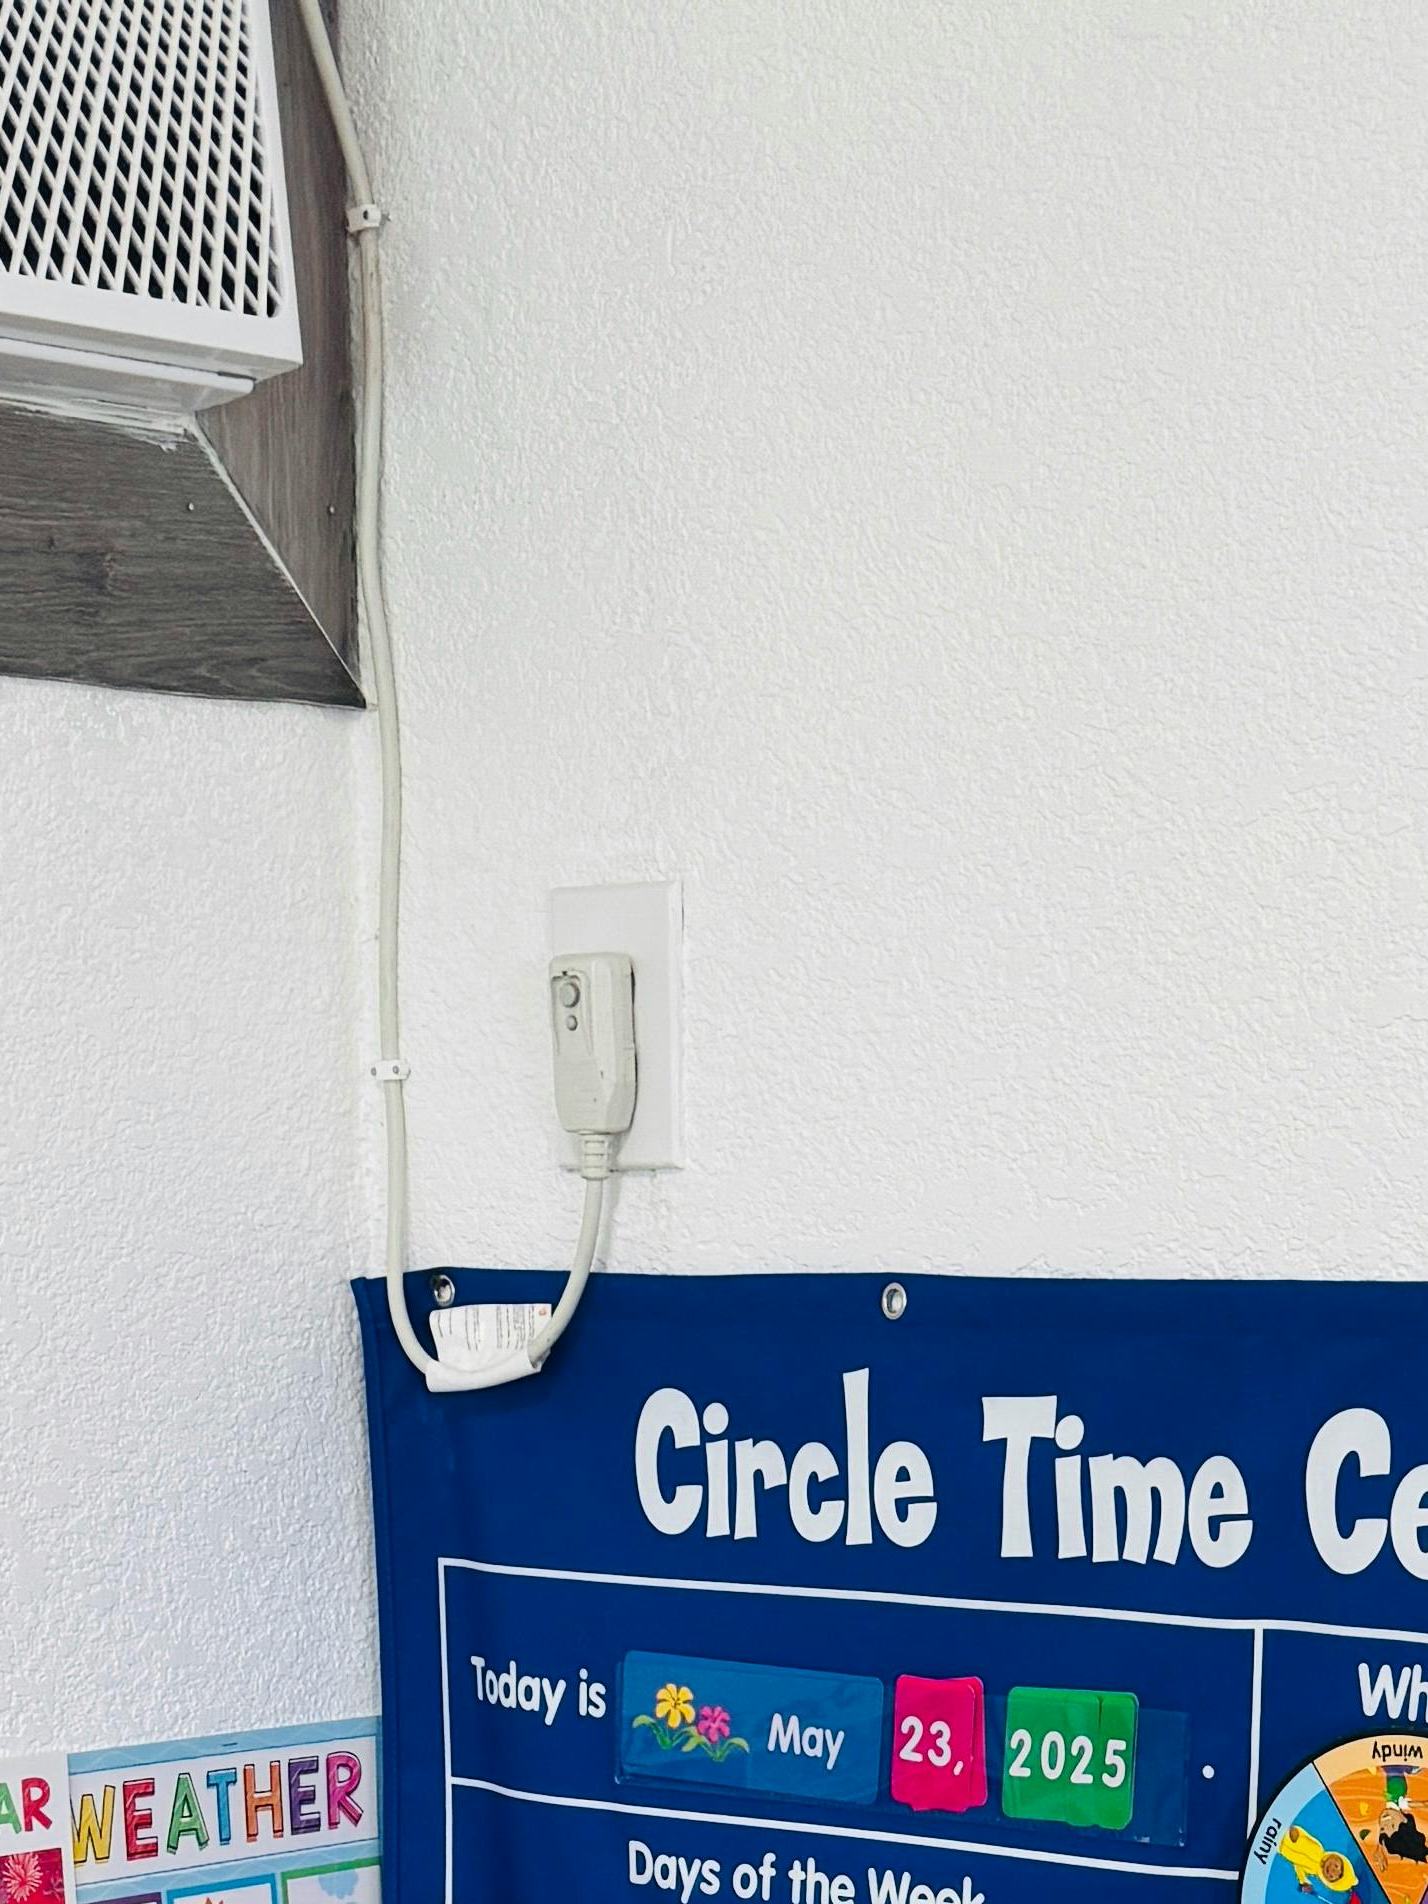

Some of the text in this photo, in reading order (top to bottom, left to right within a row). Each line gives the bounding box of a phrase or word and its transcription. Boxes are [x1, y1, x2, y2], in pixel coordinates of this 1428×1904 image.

[635, 1367, 939, 1549] Circle
[982, 1394, 1254, 1569] Time
[470, 1654, 1129, 1791] Today is May 23, 2025
[1371, 1740, 1424, 1760] windy
[72, 1750, 365, 1866] WEATHER
[1253, 1817, 1282, 1866] rainy
[733, 1853, 775, 1903] of
